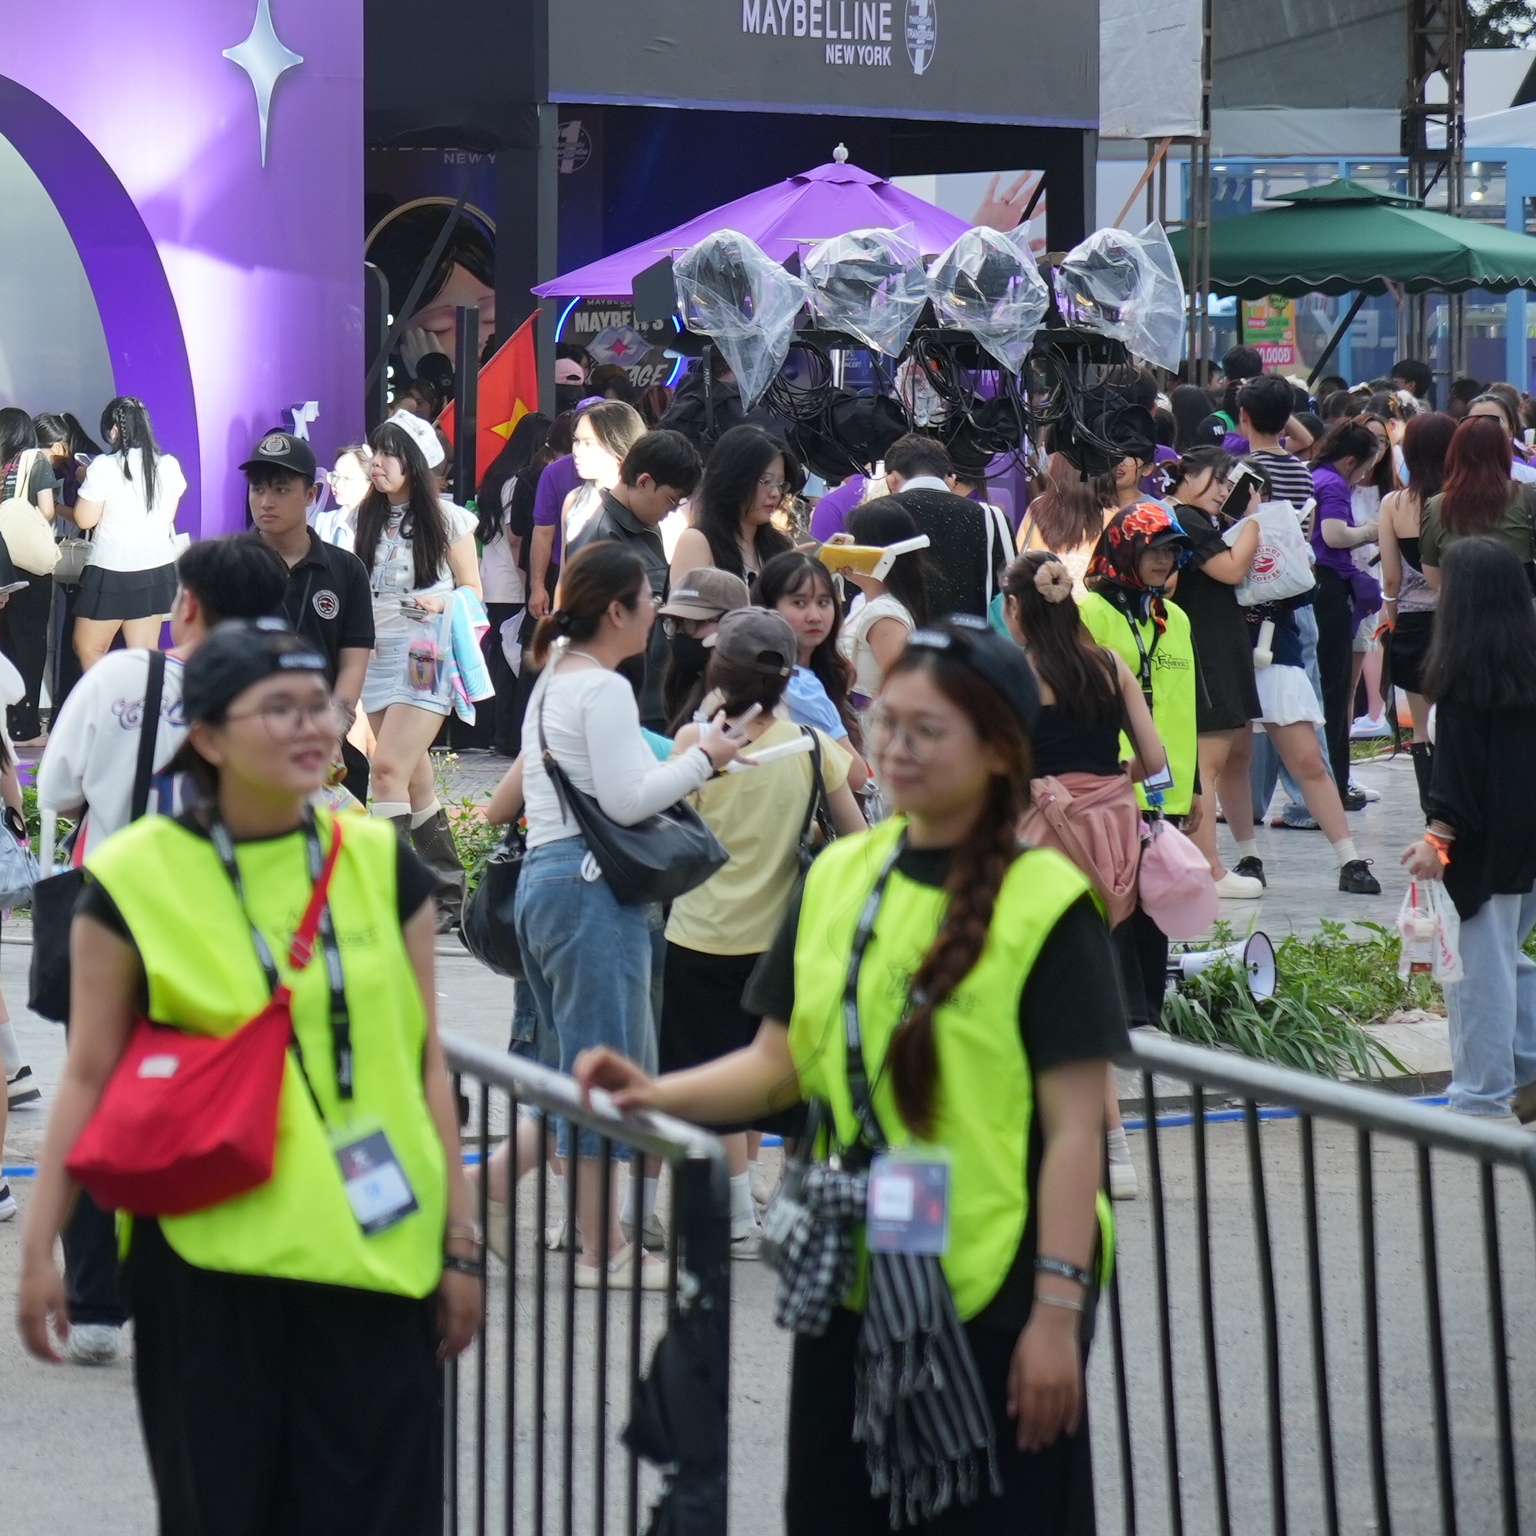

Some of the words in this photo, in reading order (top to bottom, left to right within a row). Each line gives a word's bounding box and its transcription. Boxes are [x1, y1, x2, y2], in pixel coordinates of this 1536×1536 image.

[825, 43, 854, 65] NEW
[855, 46, 892, 67] YORK
[1252, 569, 1282, 582] COFFEE
